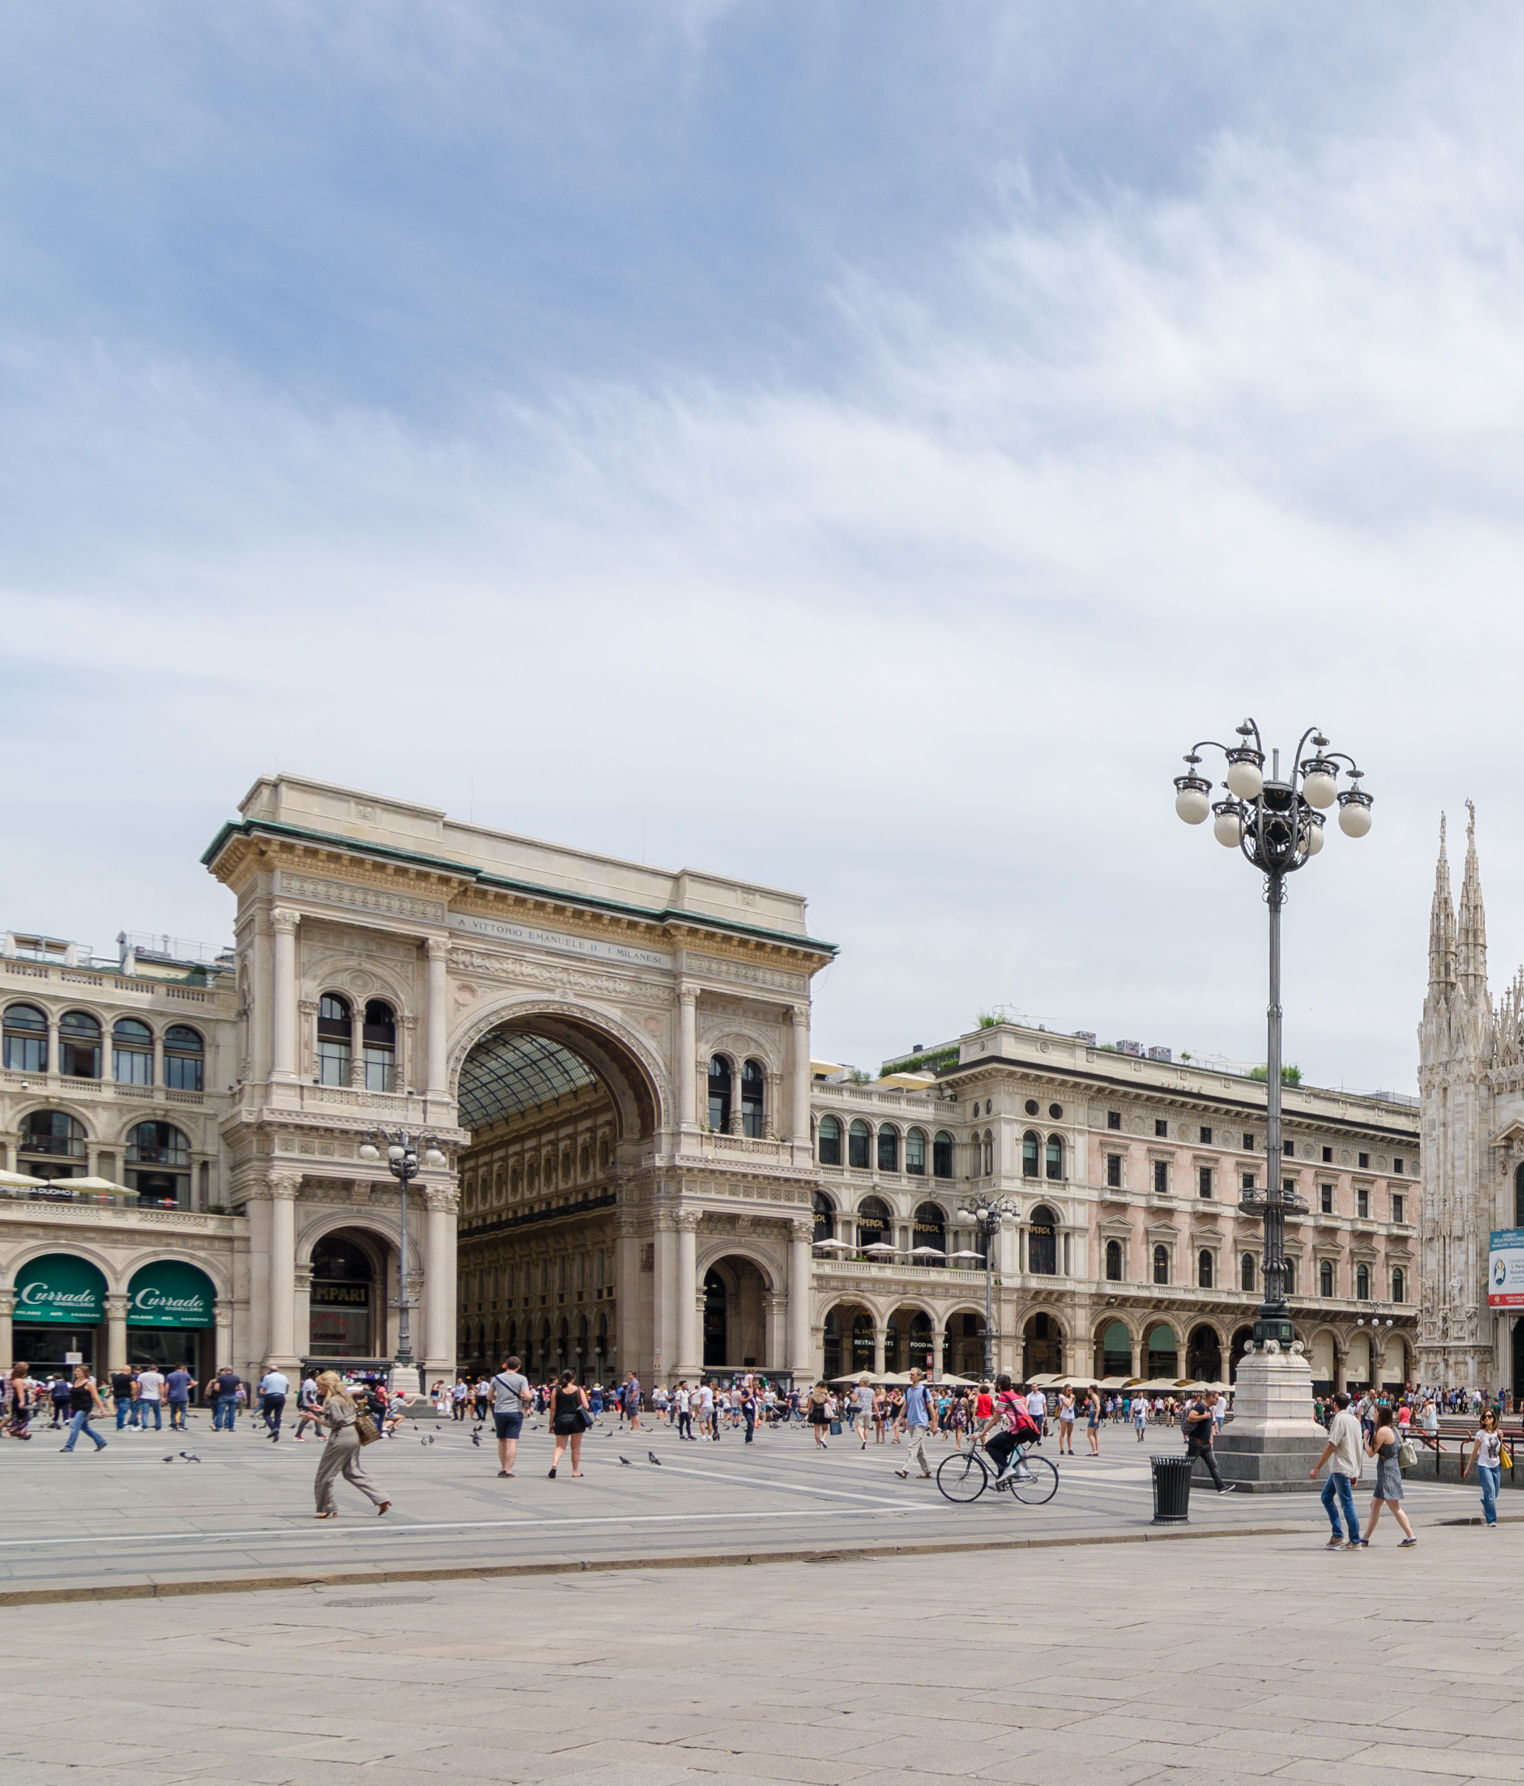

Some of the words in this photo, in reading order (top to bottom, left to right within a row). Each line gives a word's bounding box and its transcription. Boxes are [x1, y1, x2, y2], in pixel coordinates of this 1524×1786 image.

[458, 918, 466, 927] A
[473, 920, 523, 937] VITTORIO
[528, 931, 586, 950] EMANUELE
[617, 949, 661, 964] MILANESI
[38, 1187, 71, 1196] DUOMO
[21, 1282, 96, 1305] Currado
[135, 1288, 204, 1309] Currado
